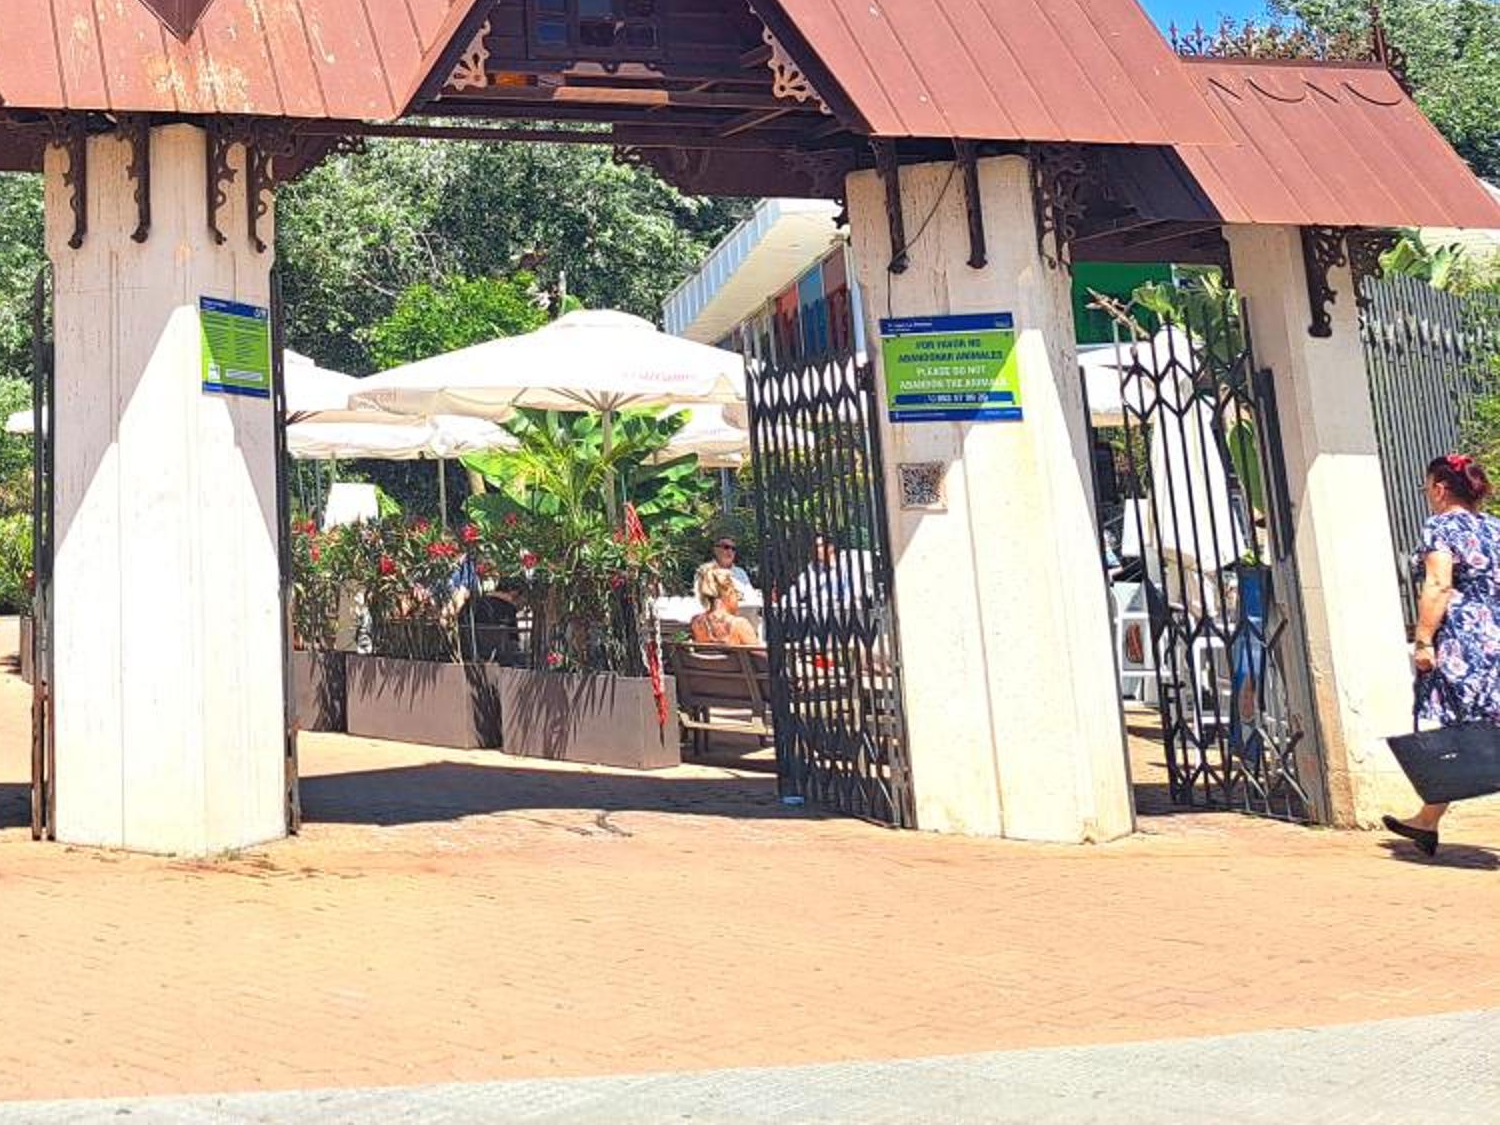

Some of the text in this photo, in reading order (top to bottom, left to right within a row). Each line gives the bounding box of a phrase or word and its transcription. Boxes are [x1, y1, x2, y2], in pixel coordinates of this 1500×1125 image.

[915, 340, 934, 350] POR
[955, 350, 1003, 362] ANIMALES
[916, 365, 986, 376] PLEASE DO NOT
